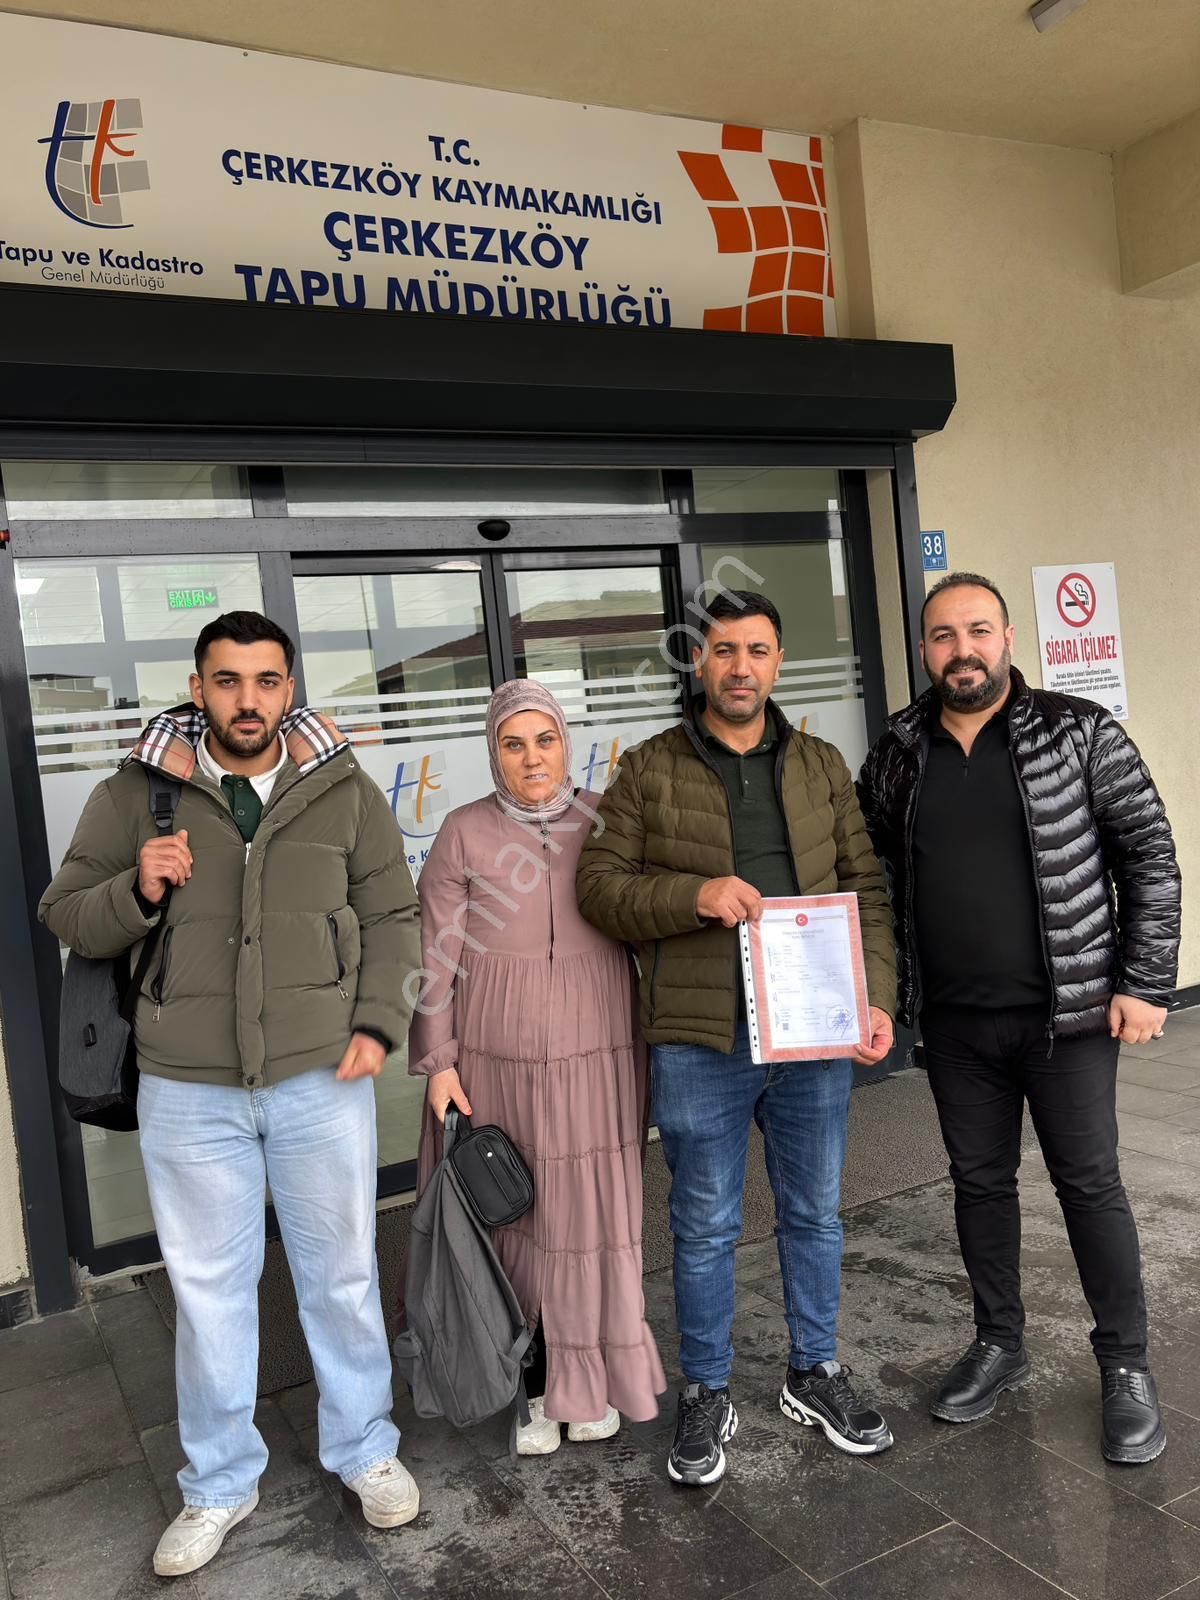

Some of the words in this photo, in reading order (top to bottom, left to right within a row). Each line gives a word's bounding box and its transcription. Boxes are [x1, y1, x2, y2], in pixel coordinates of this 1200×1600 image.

[428, 135, 480, 167] T.C.
[221, 149, 421, 198] ÇERKEZKÖY
[432, 175, 662, 225] KAYMAKAMLIĞI
[0, 240, 53, 267] Tapu
[62, 250, 90, 266] ve
[99, 248, 204, 276] Kadastro
[323, 211, 590, 271] ÇERKEZKÖY
[41, 266, 85, 284] Genel
[90, 270, 165, 291] Müdürlüğü
[234, 264, 366, 310] TAPU
[386, 270, 672, 329] MÜDÜRLÜĞÜ
[923, 535, 943, 556] 38
[168, 590, 191, 600] EXIT
[1045, 634, 1079, 666] SİGARA
[1080, 632, 1117, 668] İÇİLMEZ
